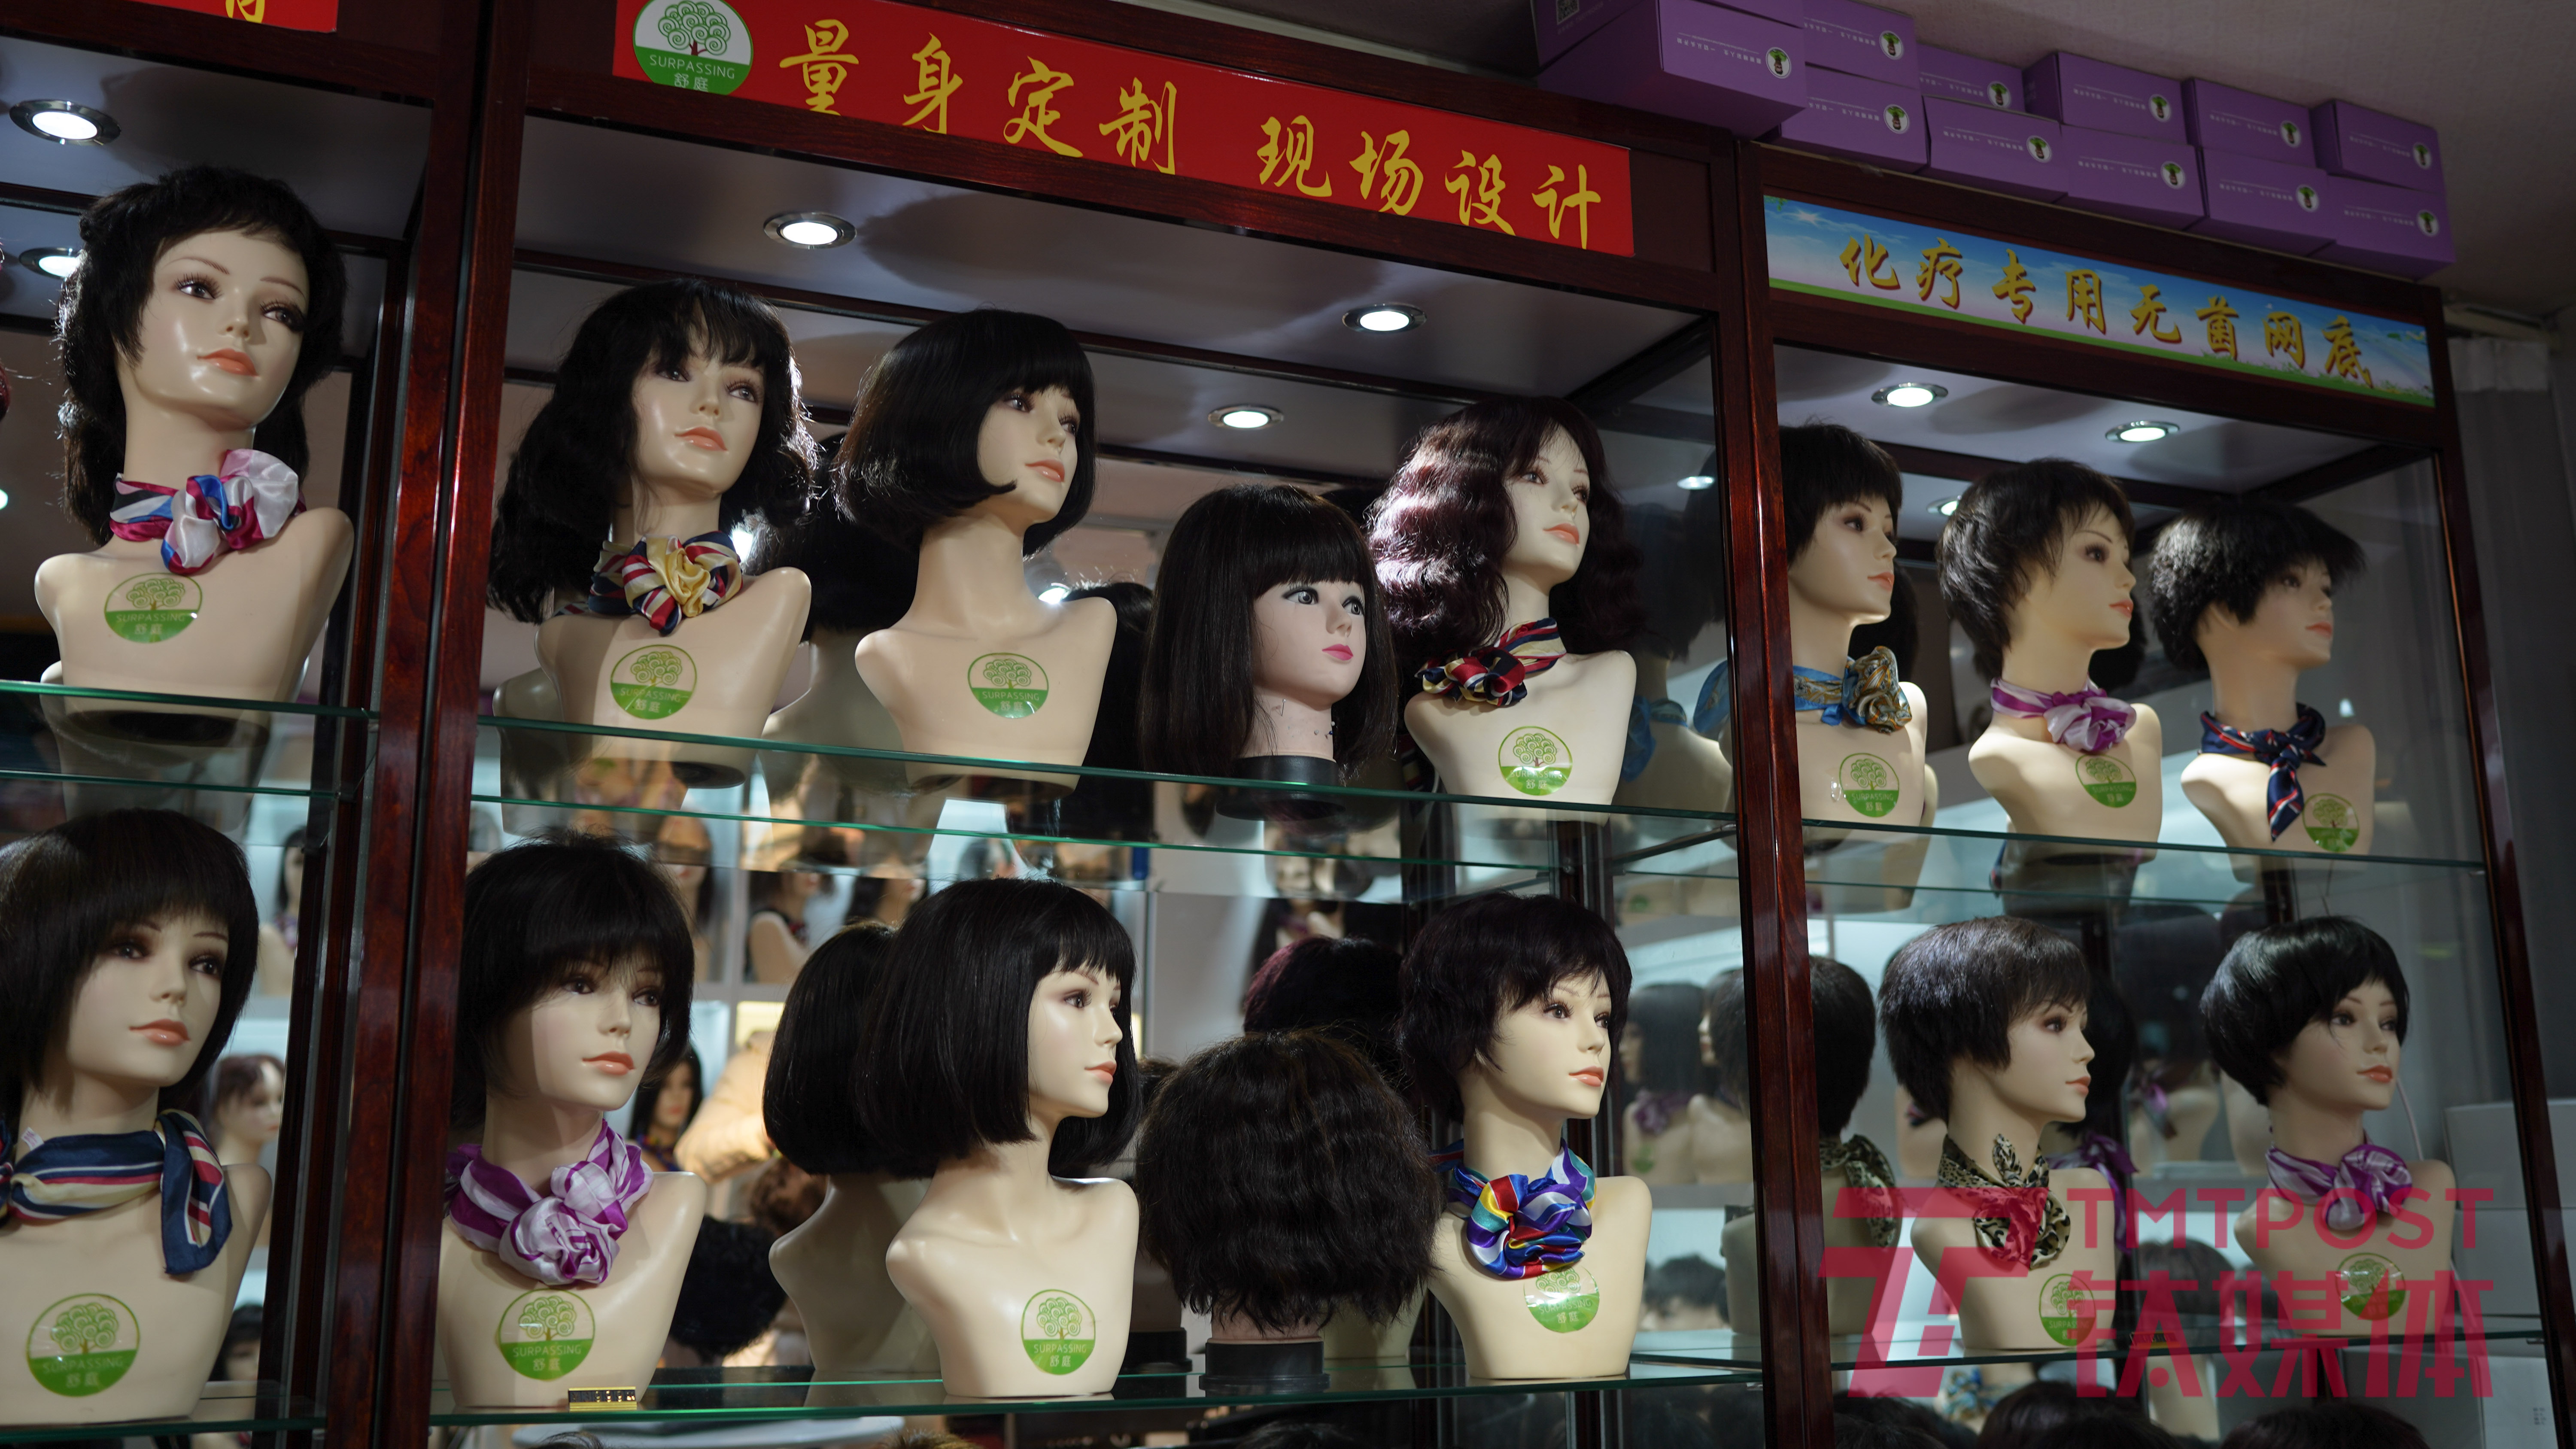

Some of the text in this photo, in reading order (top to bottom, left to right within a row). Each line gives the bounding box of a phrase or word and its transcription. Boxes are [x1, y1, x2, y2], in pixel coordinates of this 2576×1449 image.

[649, 55, 735, 79] SURPASSING
[674, 72, 708, 93] 舒庭
[780, 19, 1601, 249] 量身定制 现场设计
[1839, 233, 2374, 389] 化疗专用无菌网底
[115, 613, 185, 623] SURPASSING
[620, 687, 681, 702] SURPASSING
[982, 690, 1040, 701] SURPASSING
[1851, 793, 1894, 802] SURPASSING
[1539, 1299, 1592, 1314] SURPASSING
[513, 1344, 581, 1358] SURPASSING
[1033, 1344, 1087, 1353] SURPASSING
[1050, 1355, 1072, 1367] 舒庭
